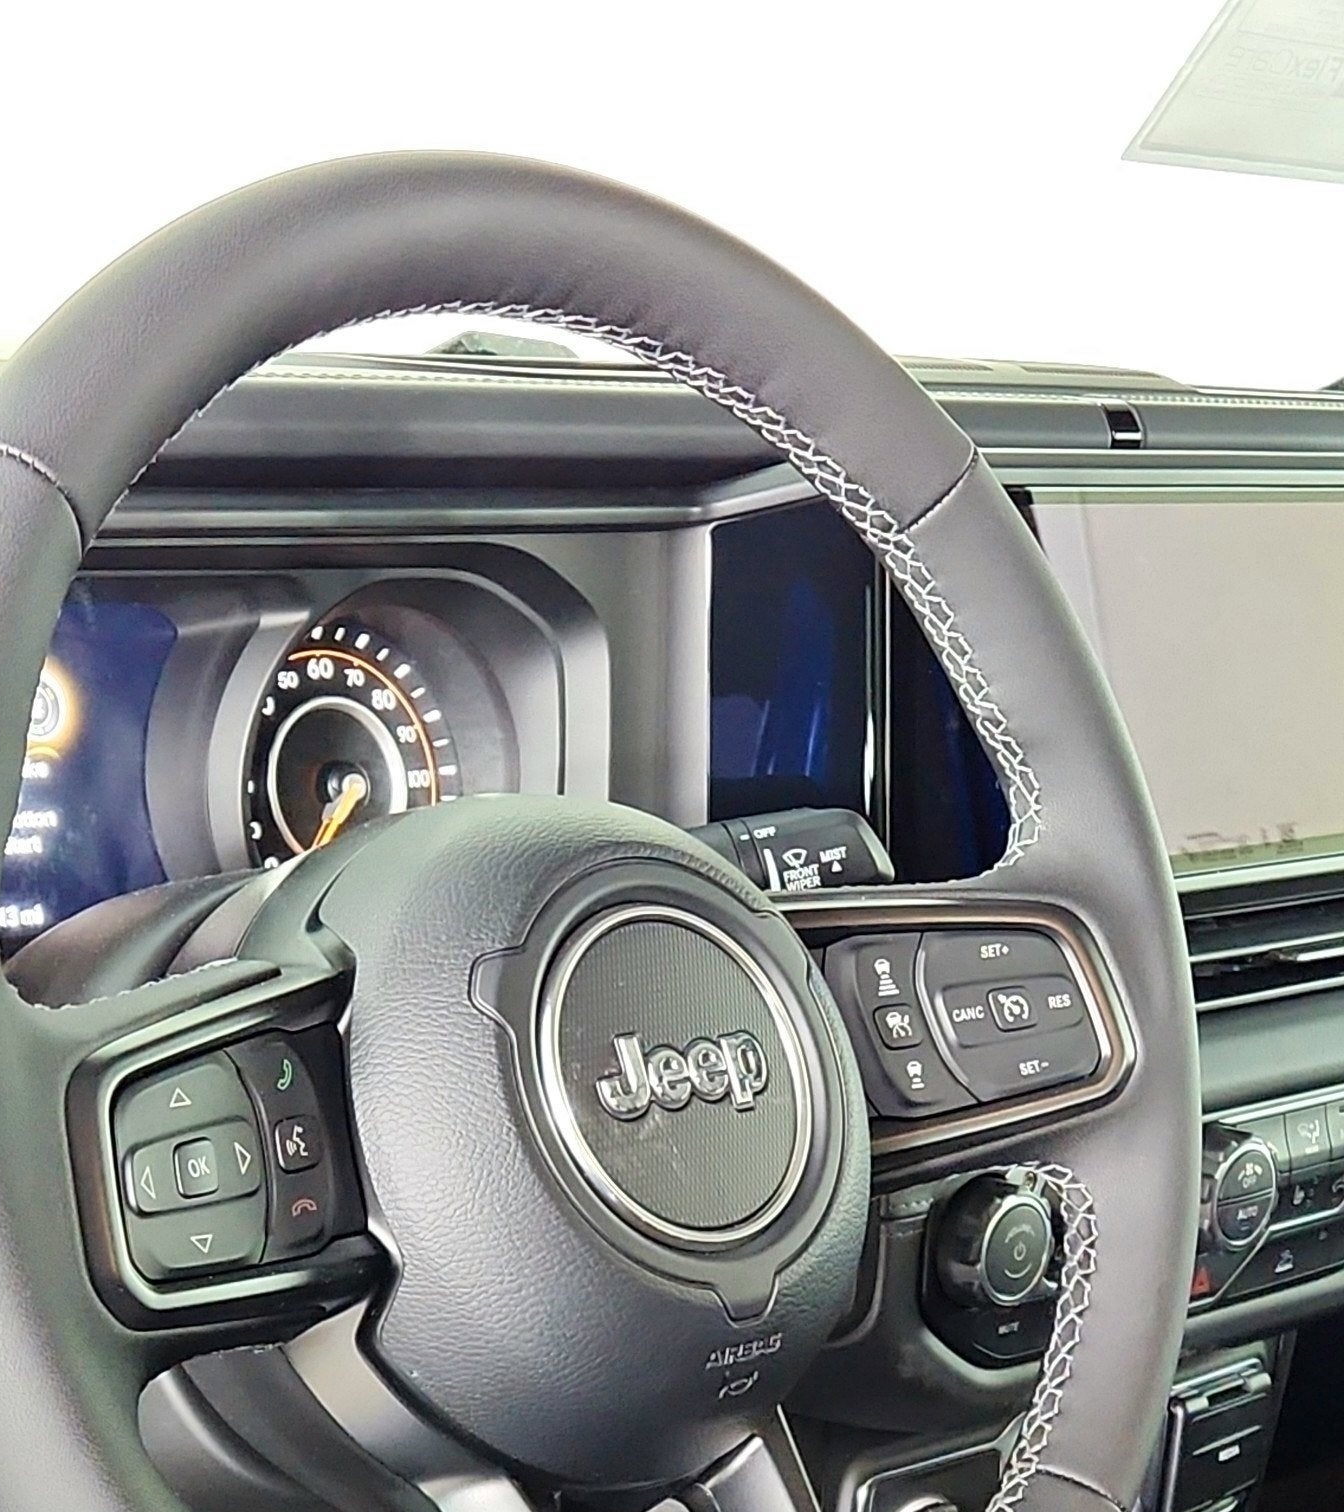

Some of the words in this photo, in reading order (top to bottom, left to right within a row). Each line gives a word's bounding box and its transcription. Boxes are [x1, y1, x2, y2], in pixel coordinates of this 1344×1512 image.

[307, 657, 334, 680] 60
[344, 668, 365, 688] 70
[277, 670, 299, 690] 50
[371, 688, 397, 711] 80
[396, 724, 417, 744] 90
[407, 769, 431, 789] 100
[753, 825, 777, 840] OFF
[819, 846, 847, 863] MIST
[782, 863, 820, 882] FRONT
[784, 875, 822, 892] WIPER
[1047, 993, 1072, 1010] RES
[952, 1005, 985, 1023] CANC
[595, 1030, 769, 1122] Jeep
[187, 1156, 210, 1178] OK
[704, 1332, 783, 1371] AIRBAG
